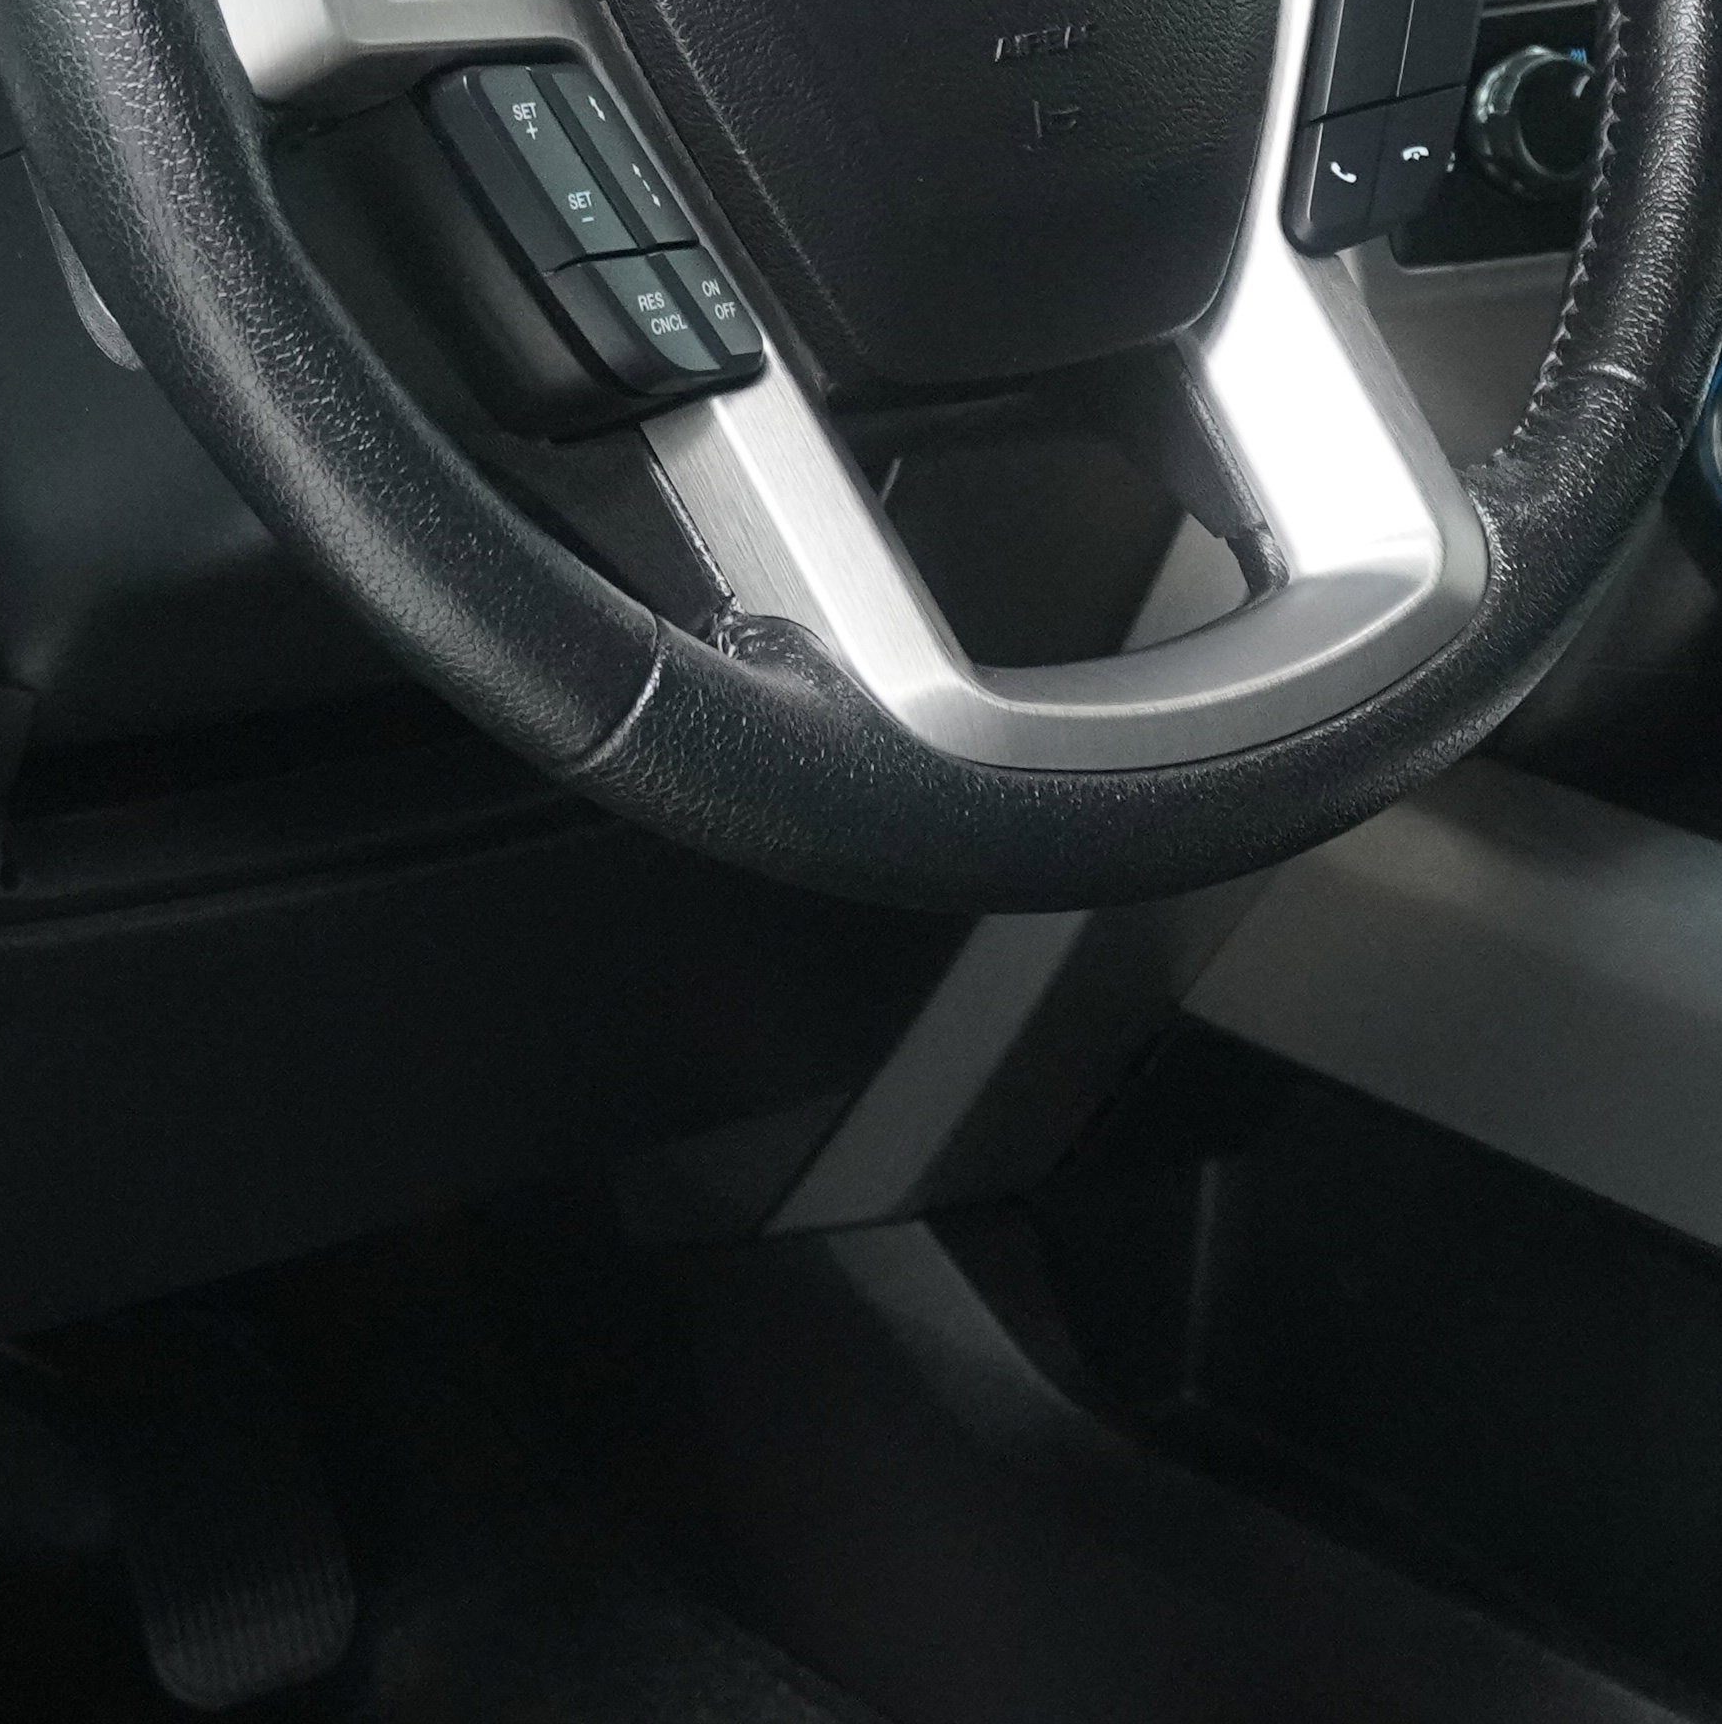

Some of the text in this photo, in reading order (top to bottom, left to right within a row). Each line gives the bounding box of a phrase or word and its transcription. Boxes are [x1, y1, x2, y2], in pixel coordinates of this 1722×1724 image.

[511, 101, 538, 122] SET
[567, 189, 593, 211] SET
[700, 279, 722, 298] ON
[637, 291, 666, 313] RES
[714, 301, 737, 321] OFF
[650, 313, 689, 336] CNCL
